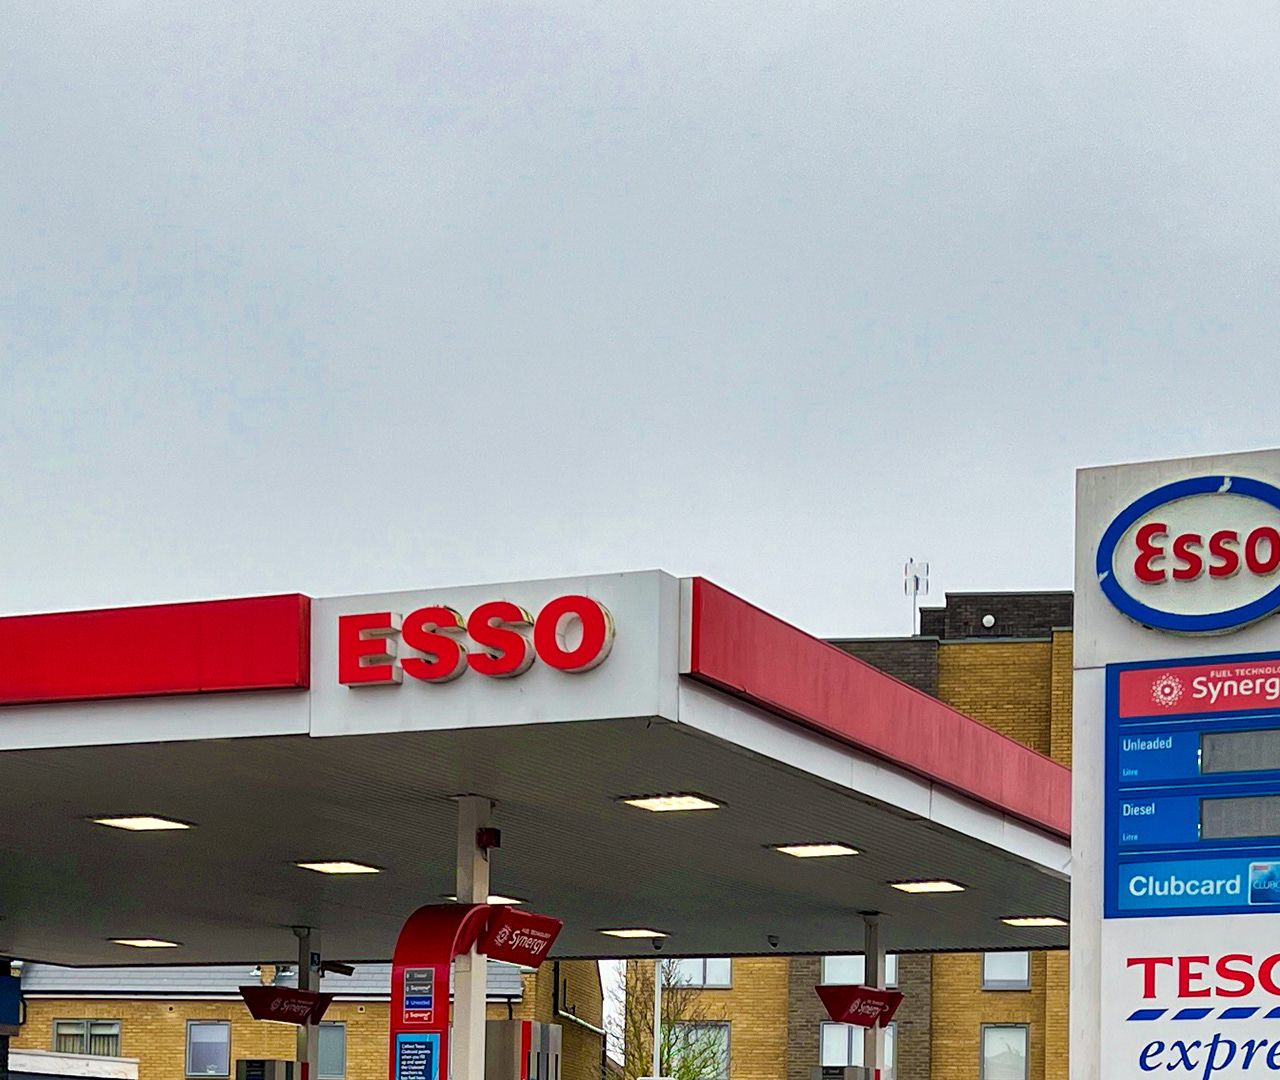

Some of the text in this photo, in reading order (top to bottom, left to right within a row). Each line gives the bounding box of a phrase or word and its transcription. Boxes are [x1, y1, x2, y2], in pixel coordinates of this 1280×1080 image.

[338, 595, 614, 687] ESSO
[1210, 668, 1232, 678] FUEL
[1122, 736, 1173, 752] Unleaded
[1122, 768, 1138, 776] Litre
[1122, 802, 1156, 817] Diesel
[1122, 833, 1138, 841] Litre
[1128, 874, 1241, 897] Clubcard
[508, 929, 547, 955] Synergy
